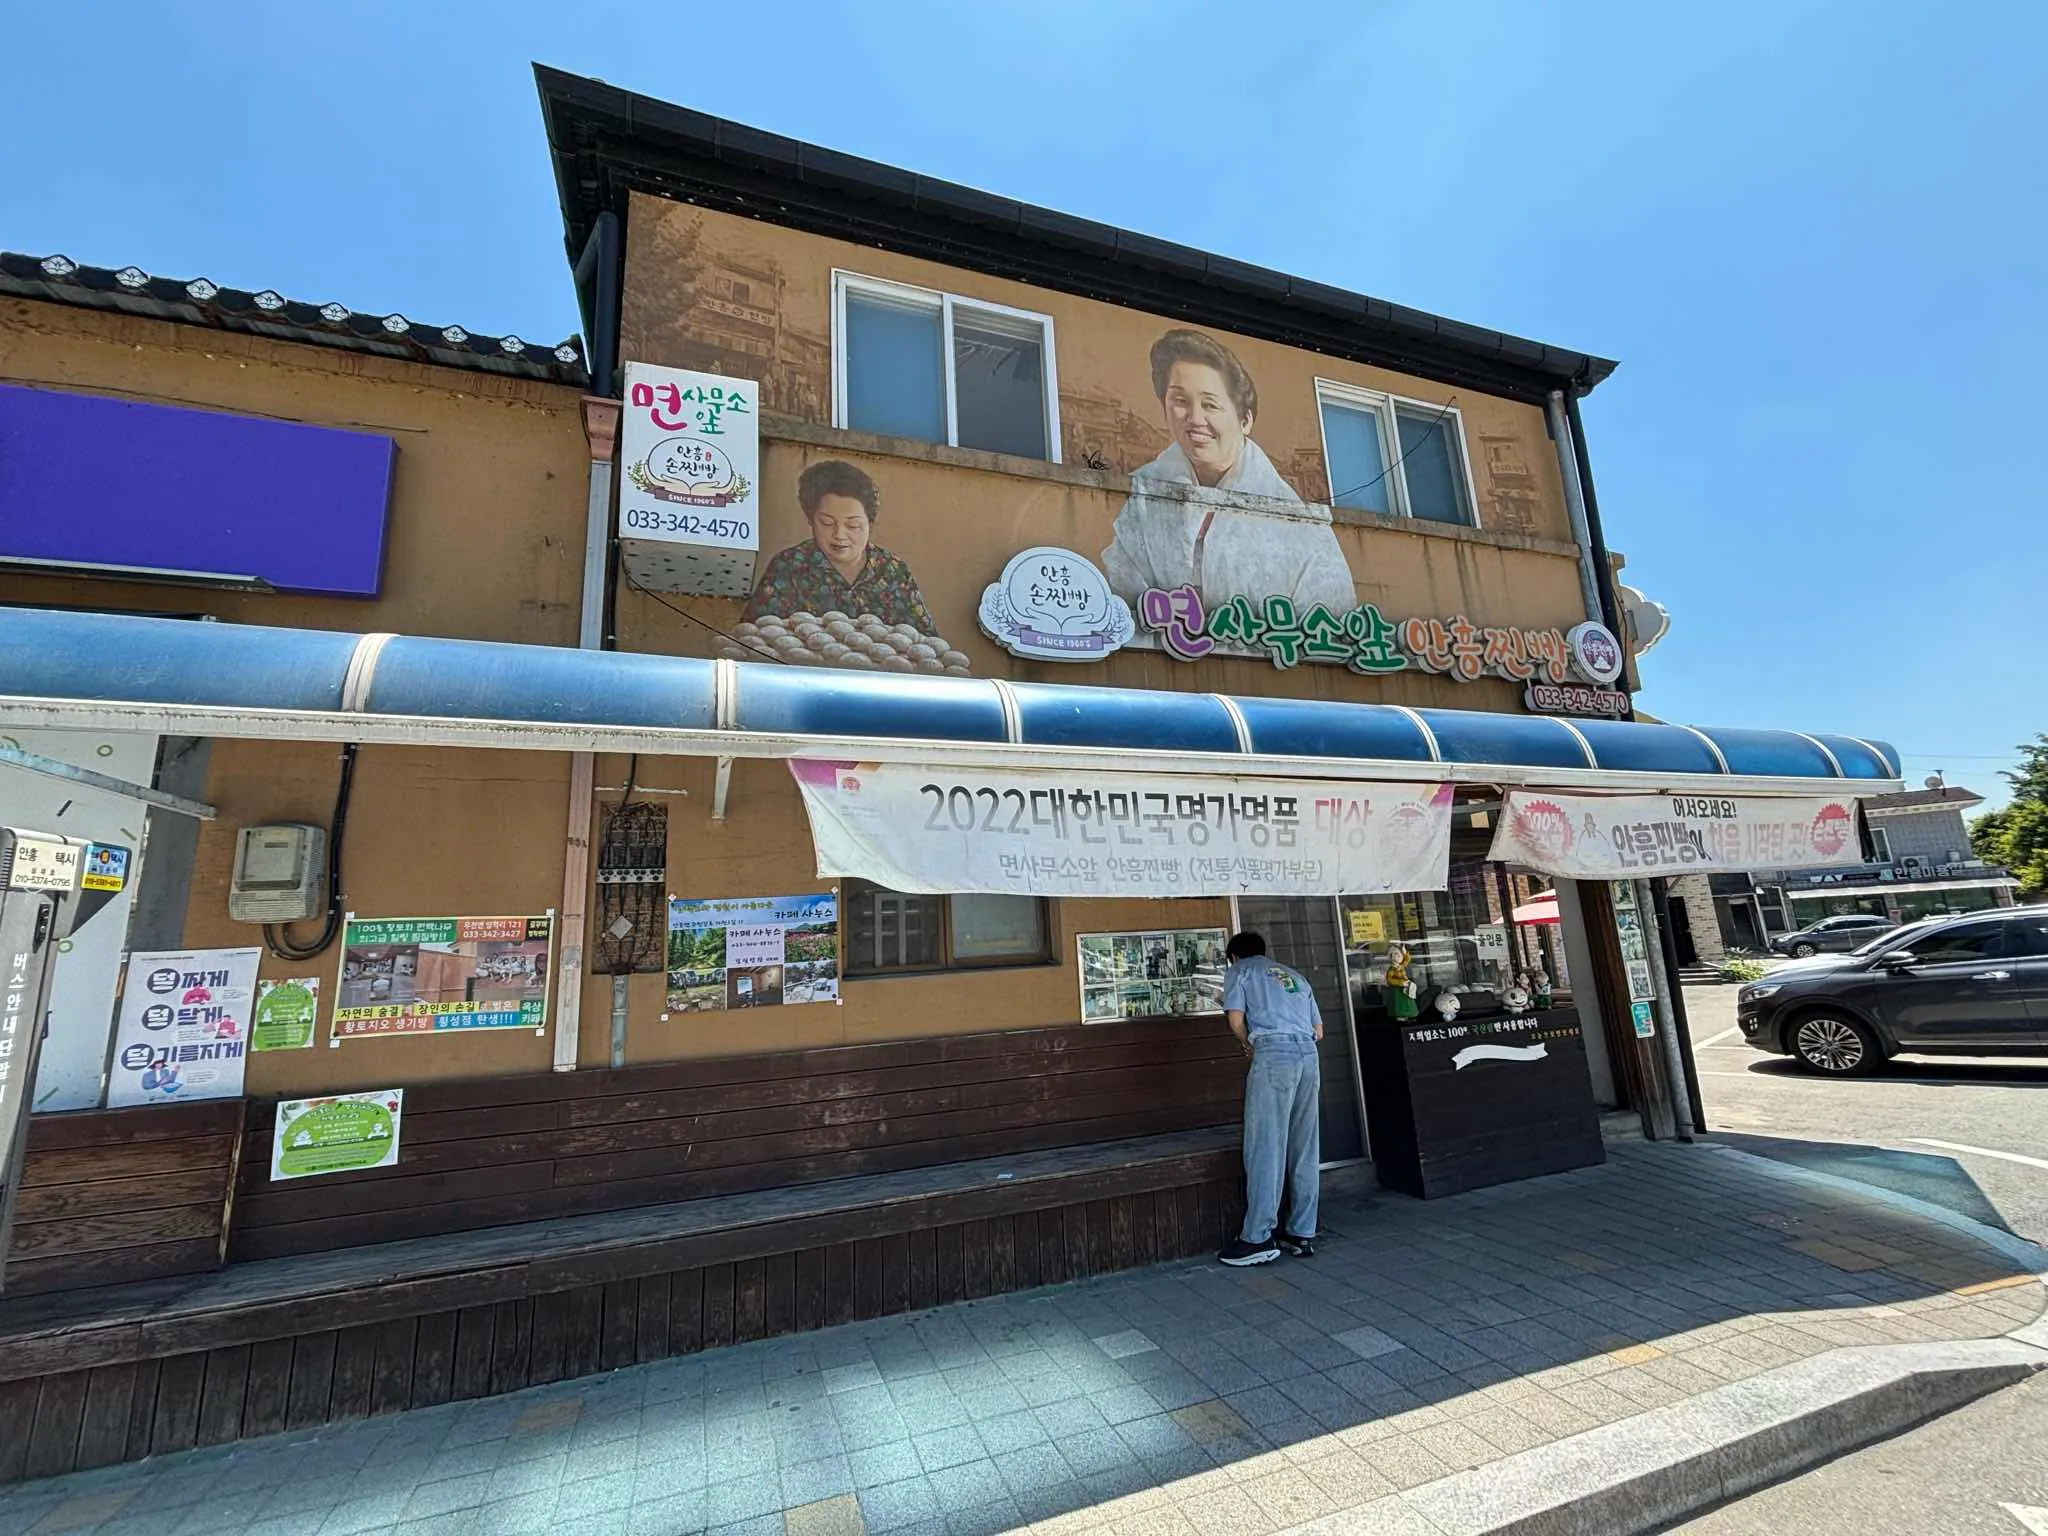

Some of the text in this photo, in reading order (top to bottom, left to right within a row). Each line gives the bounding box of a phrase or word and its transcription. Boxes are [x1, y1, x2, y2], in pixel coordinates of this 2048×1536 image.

[696, 409, 725, 435] 앞
[676, 445, 704, 462] 안흥
[665, 457, 720, 479] 손찐빵
[627, 509, 750, 539] 033-342-4570
[1040, 565, 1072, 586] 안흥
[1029, 583, 1091, 610] 손찐빵
[1036, 635, 1065, 648] SINCE
[1406, 616, 1569, 683] 안흥찐빵
[1535, 687, 1628, 713] 033-342-4570
[1672, 798, 1737, 819] 어서오세요!
[1314, 797, 1374, 850] 대상
[55, 851, 76, 866] 택시
[999, 853, 1098, 882] 면사무소앞
[1106, 856, 1182, 883] 안흥찐빵
[774, 910, 799, 919] 카페
[729, 929, 751, 938] 카페
[152, 971, 177, 991] 덜
[146, 1007, 171, 1027] 덜
[340, 1007, 373, 1019] 자연의
[418, 1002, 450, 1015] 장인의
[344, 1020, 390, 1034] 황토지오
[126, 1047, 150, 1067] 덜
